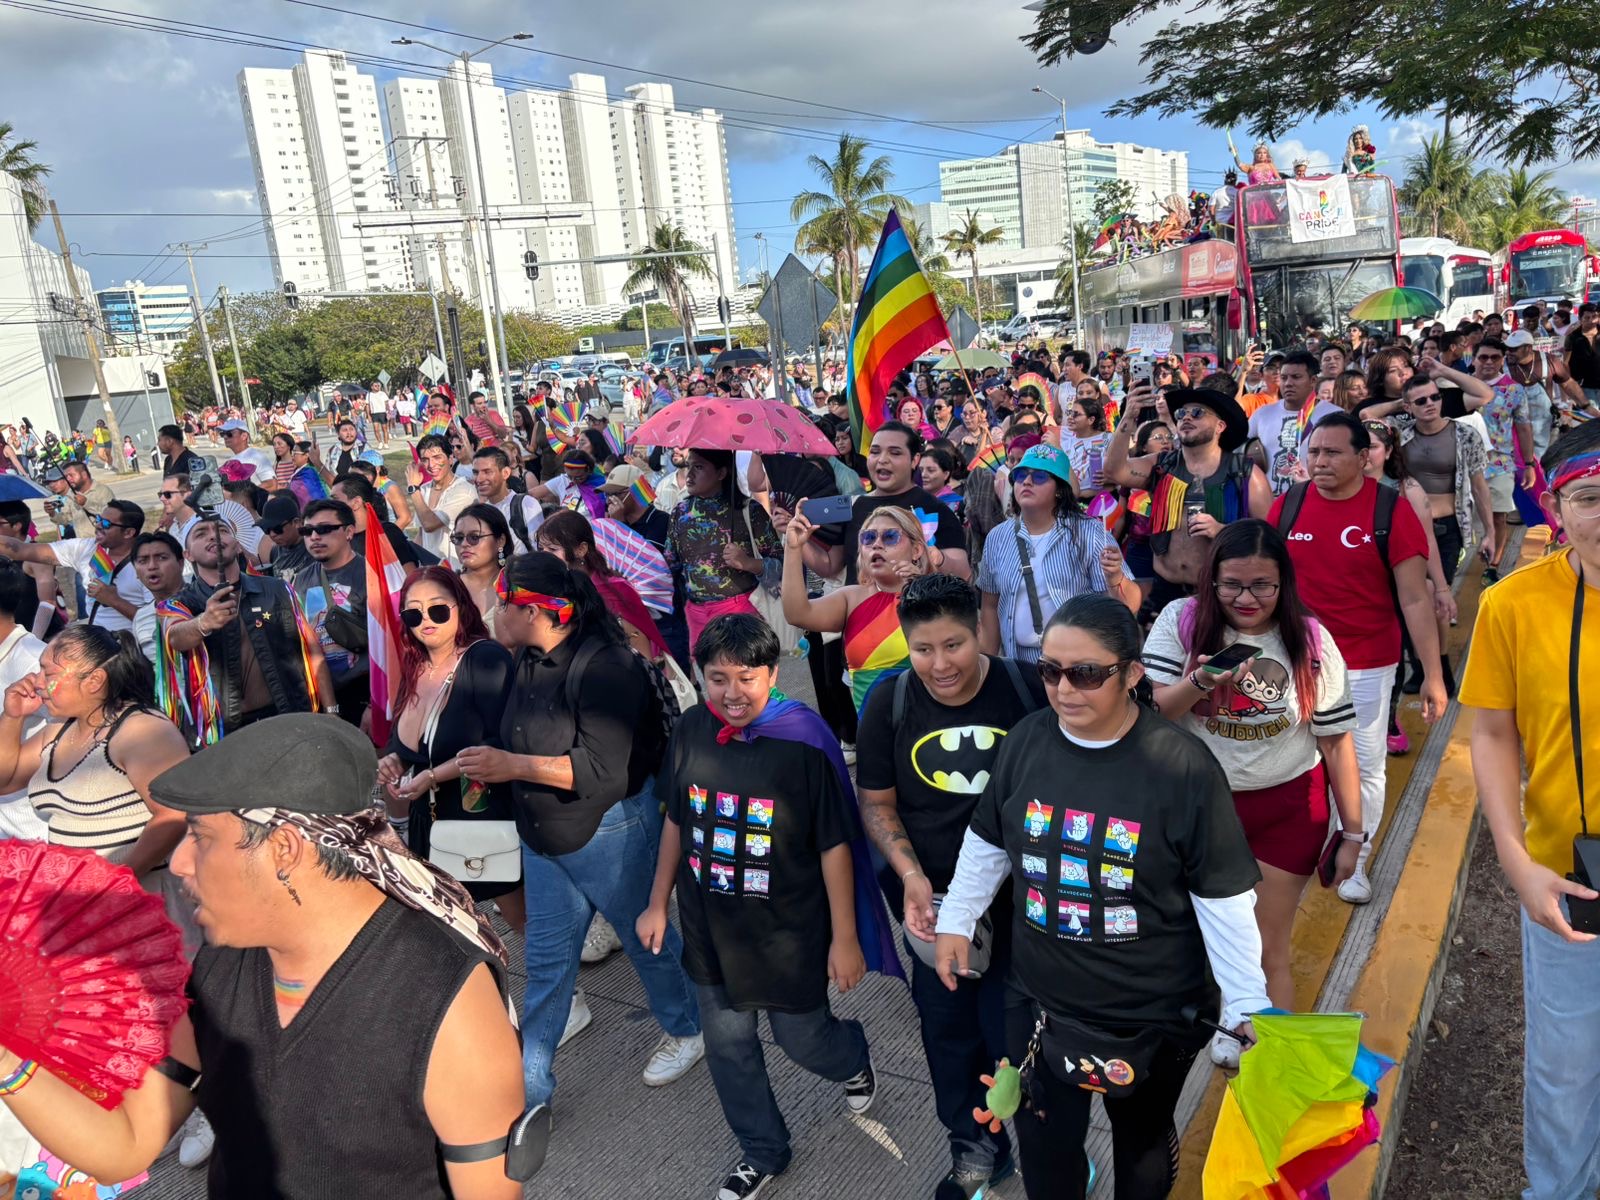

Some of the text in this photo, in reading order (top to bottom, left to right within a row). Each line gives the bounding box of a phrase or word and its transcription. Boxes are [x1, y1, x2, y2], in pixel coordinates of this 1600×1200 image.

[1305, 217, 1339, 230] PRIDE
[1287, 530, 1313, 541] Leo
[1206, 714, 1291, 741] QUIDDITCH
